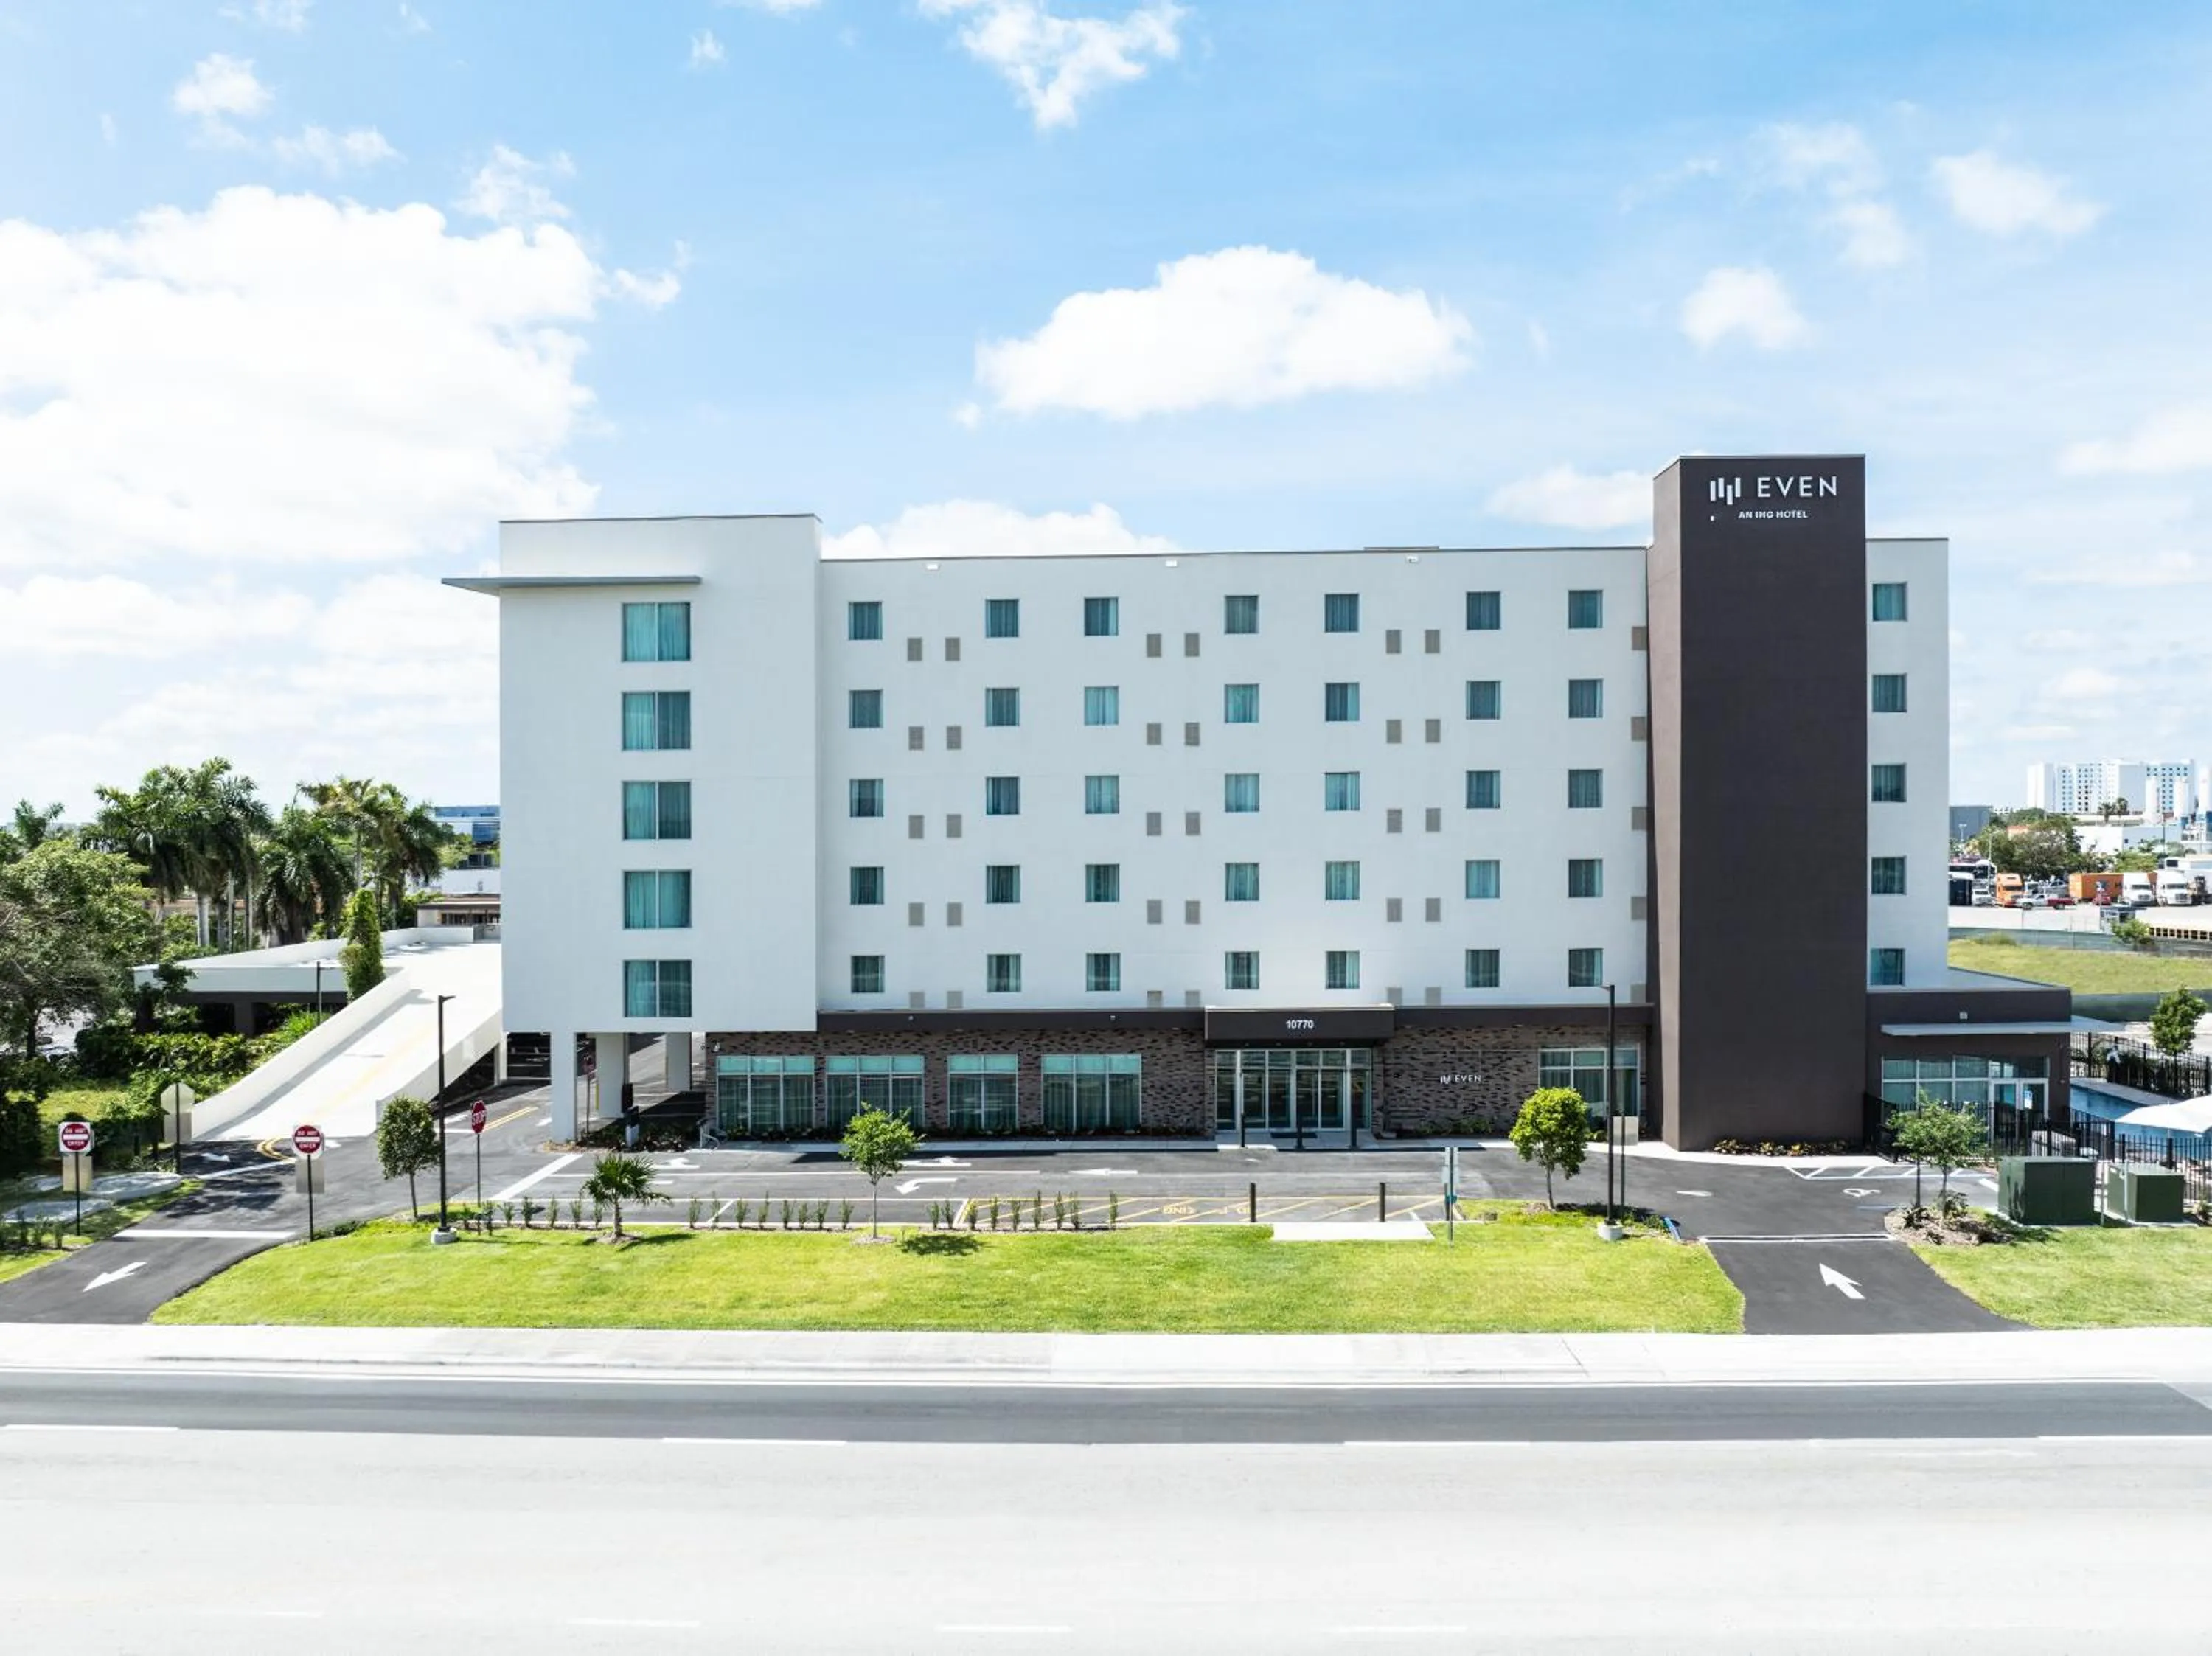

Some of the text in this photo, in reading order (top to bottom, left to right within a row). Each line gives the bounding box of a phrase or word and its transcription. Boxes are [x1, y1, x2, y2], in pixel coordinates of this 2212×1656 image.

[1757, 476, 1837, 498] EVEN
[1739, 510, 1809, 519] AN IHG HOTEL
[1286, 1020, 1314, 1029] 10770
[1455, 1074, 1481, 1083] EVEN
